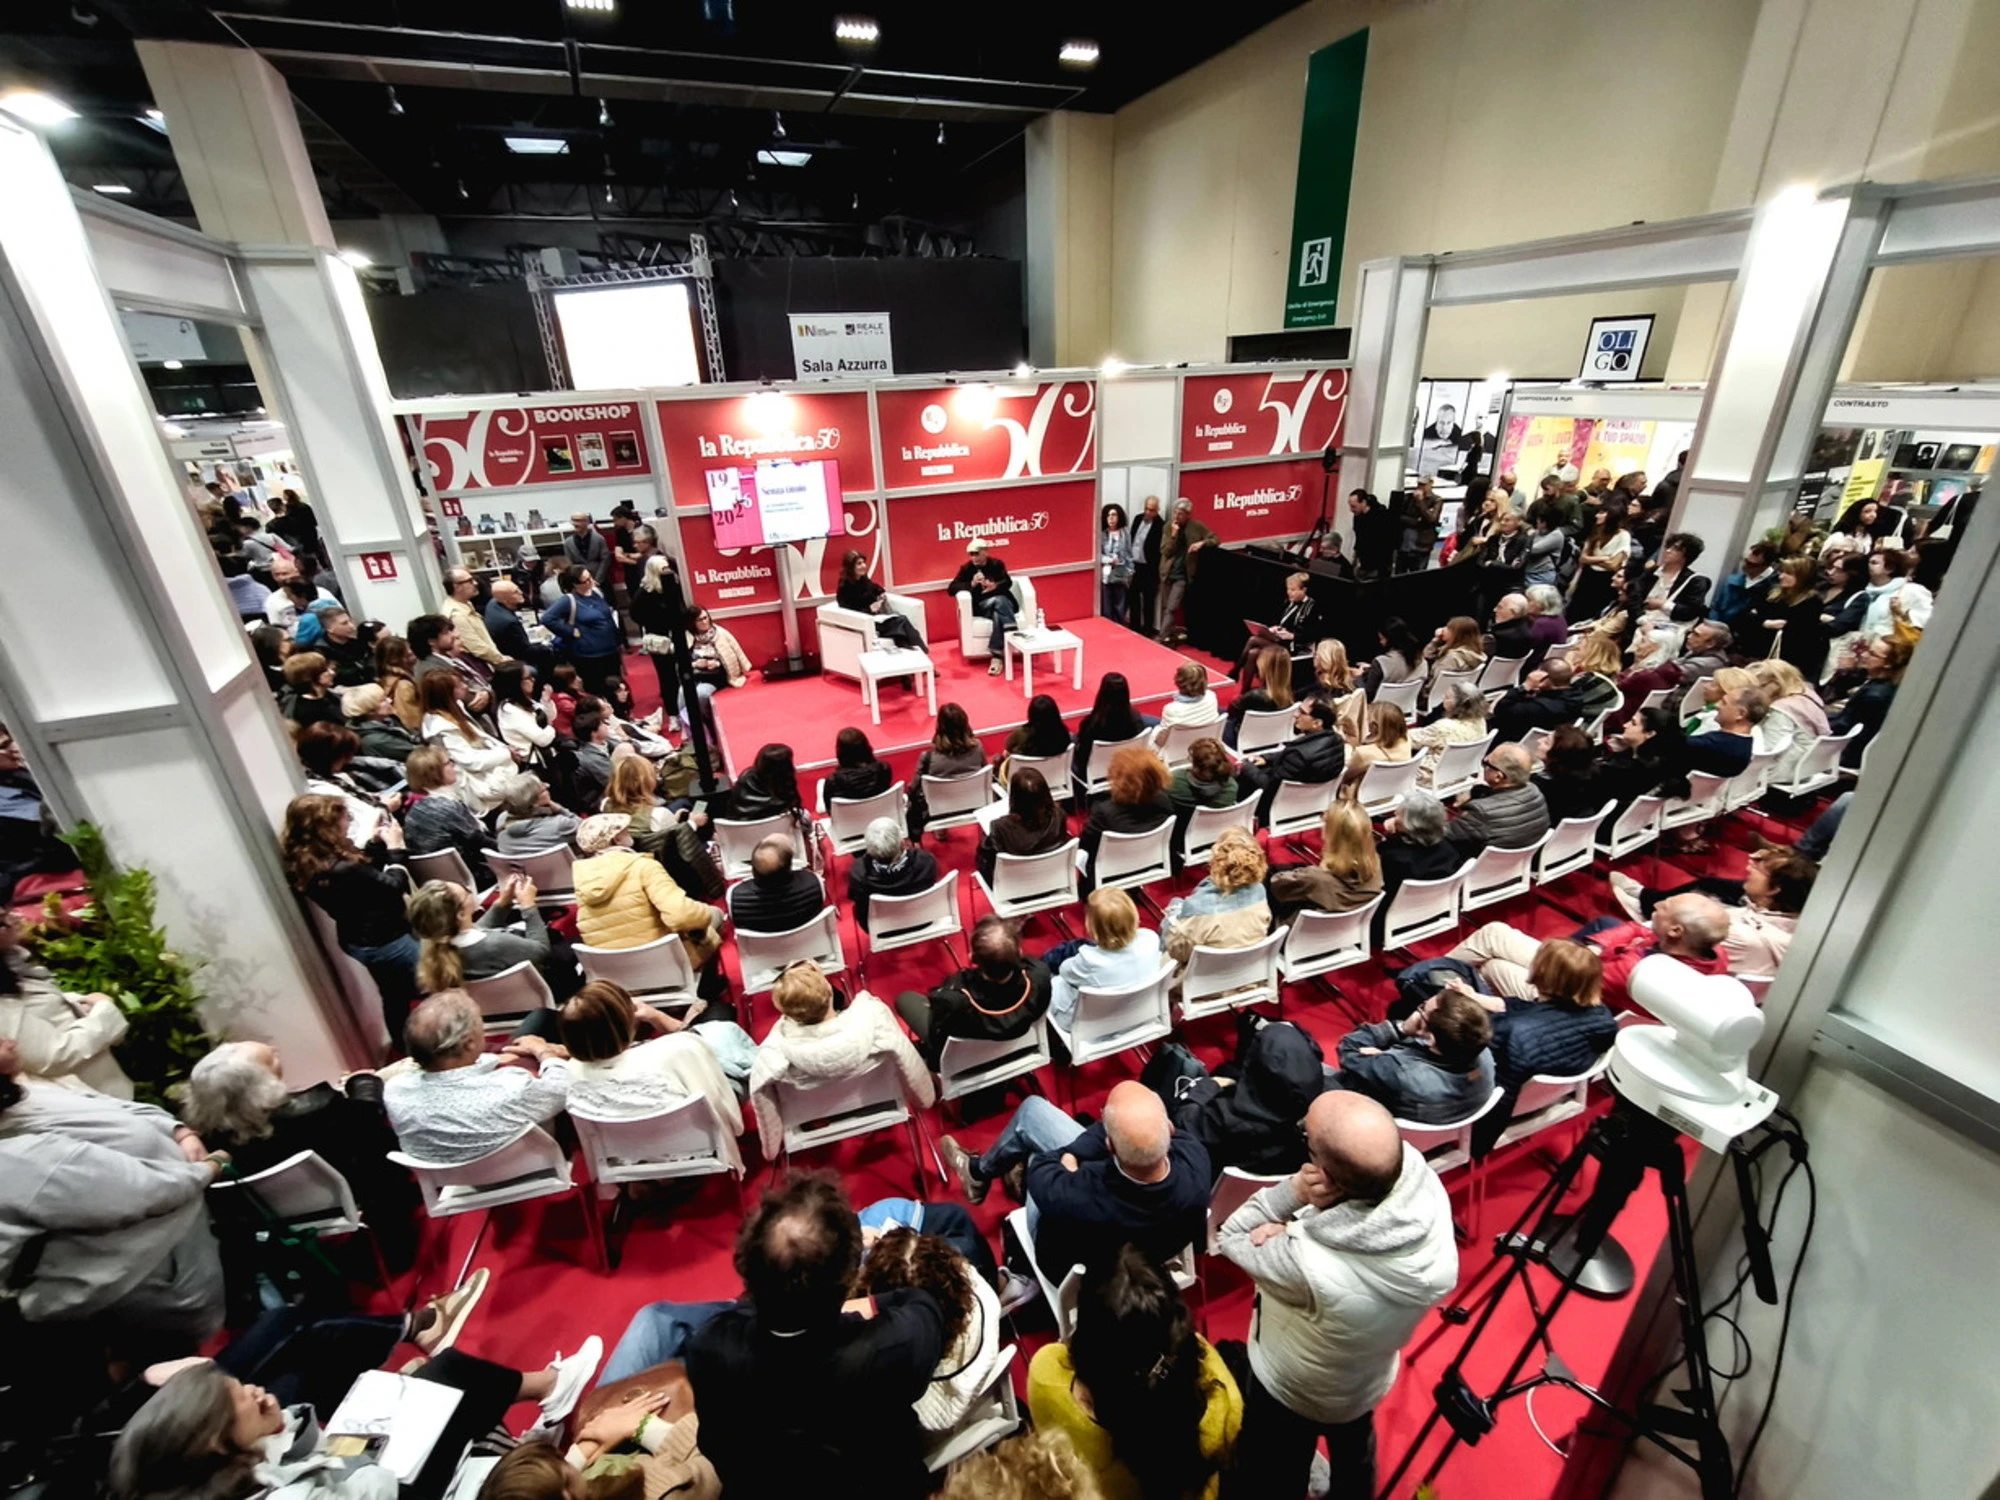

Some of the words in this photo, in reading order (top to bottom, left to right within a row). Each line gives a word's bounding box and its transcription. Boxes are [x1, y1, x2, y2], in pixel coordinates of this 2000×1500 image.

[1599, 331, 1635, 350] OLI
[802, 359, 834, 373] Sala
[837, 359, 888, 372] Azzurra
[1594, 353, 1630, 371] GO
[1258, 368, 1348, 456] 50
[1833, 399, 1889, 408] CONTRASTO
[533, 405, 632, 424] BOOKSHOP
[982, 381, 1097, 480] 50
[1195, 425, 1203, 438] la
[1204, 422, 1247, 438] Repubblica
[698, 435, 718, 458] la
[815, 427, 841, 450] 50
[902, 446, 913, 461] la
[914, 442, 971, 461] Repubblica
[1213, 493, 1225, 510] la
[1226, 488, 1286, 510] Repubblica
[1286, 484, 1302, 501] 50
[937, 523, 952, 541] la
[953, 515, 1029, 540] Repubblica
[1029, 511, 1049, 531] 50
[694, 570, 708, 585] la
[708, 565, 772, 584] Repubblica
